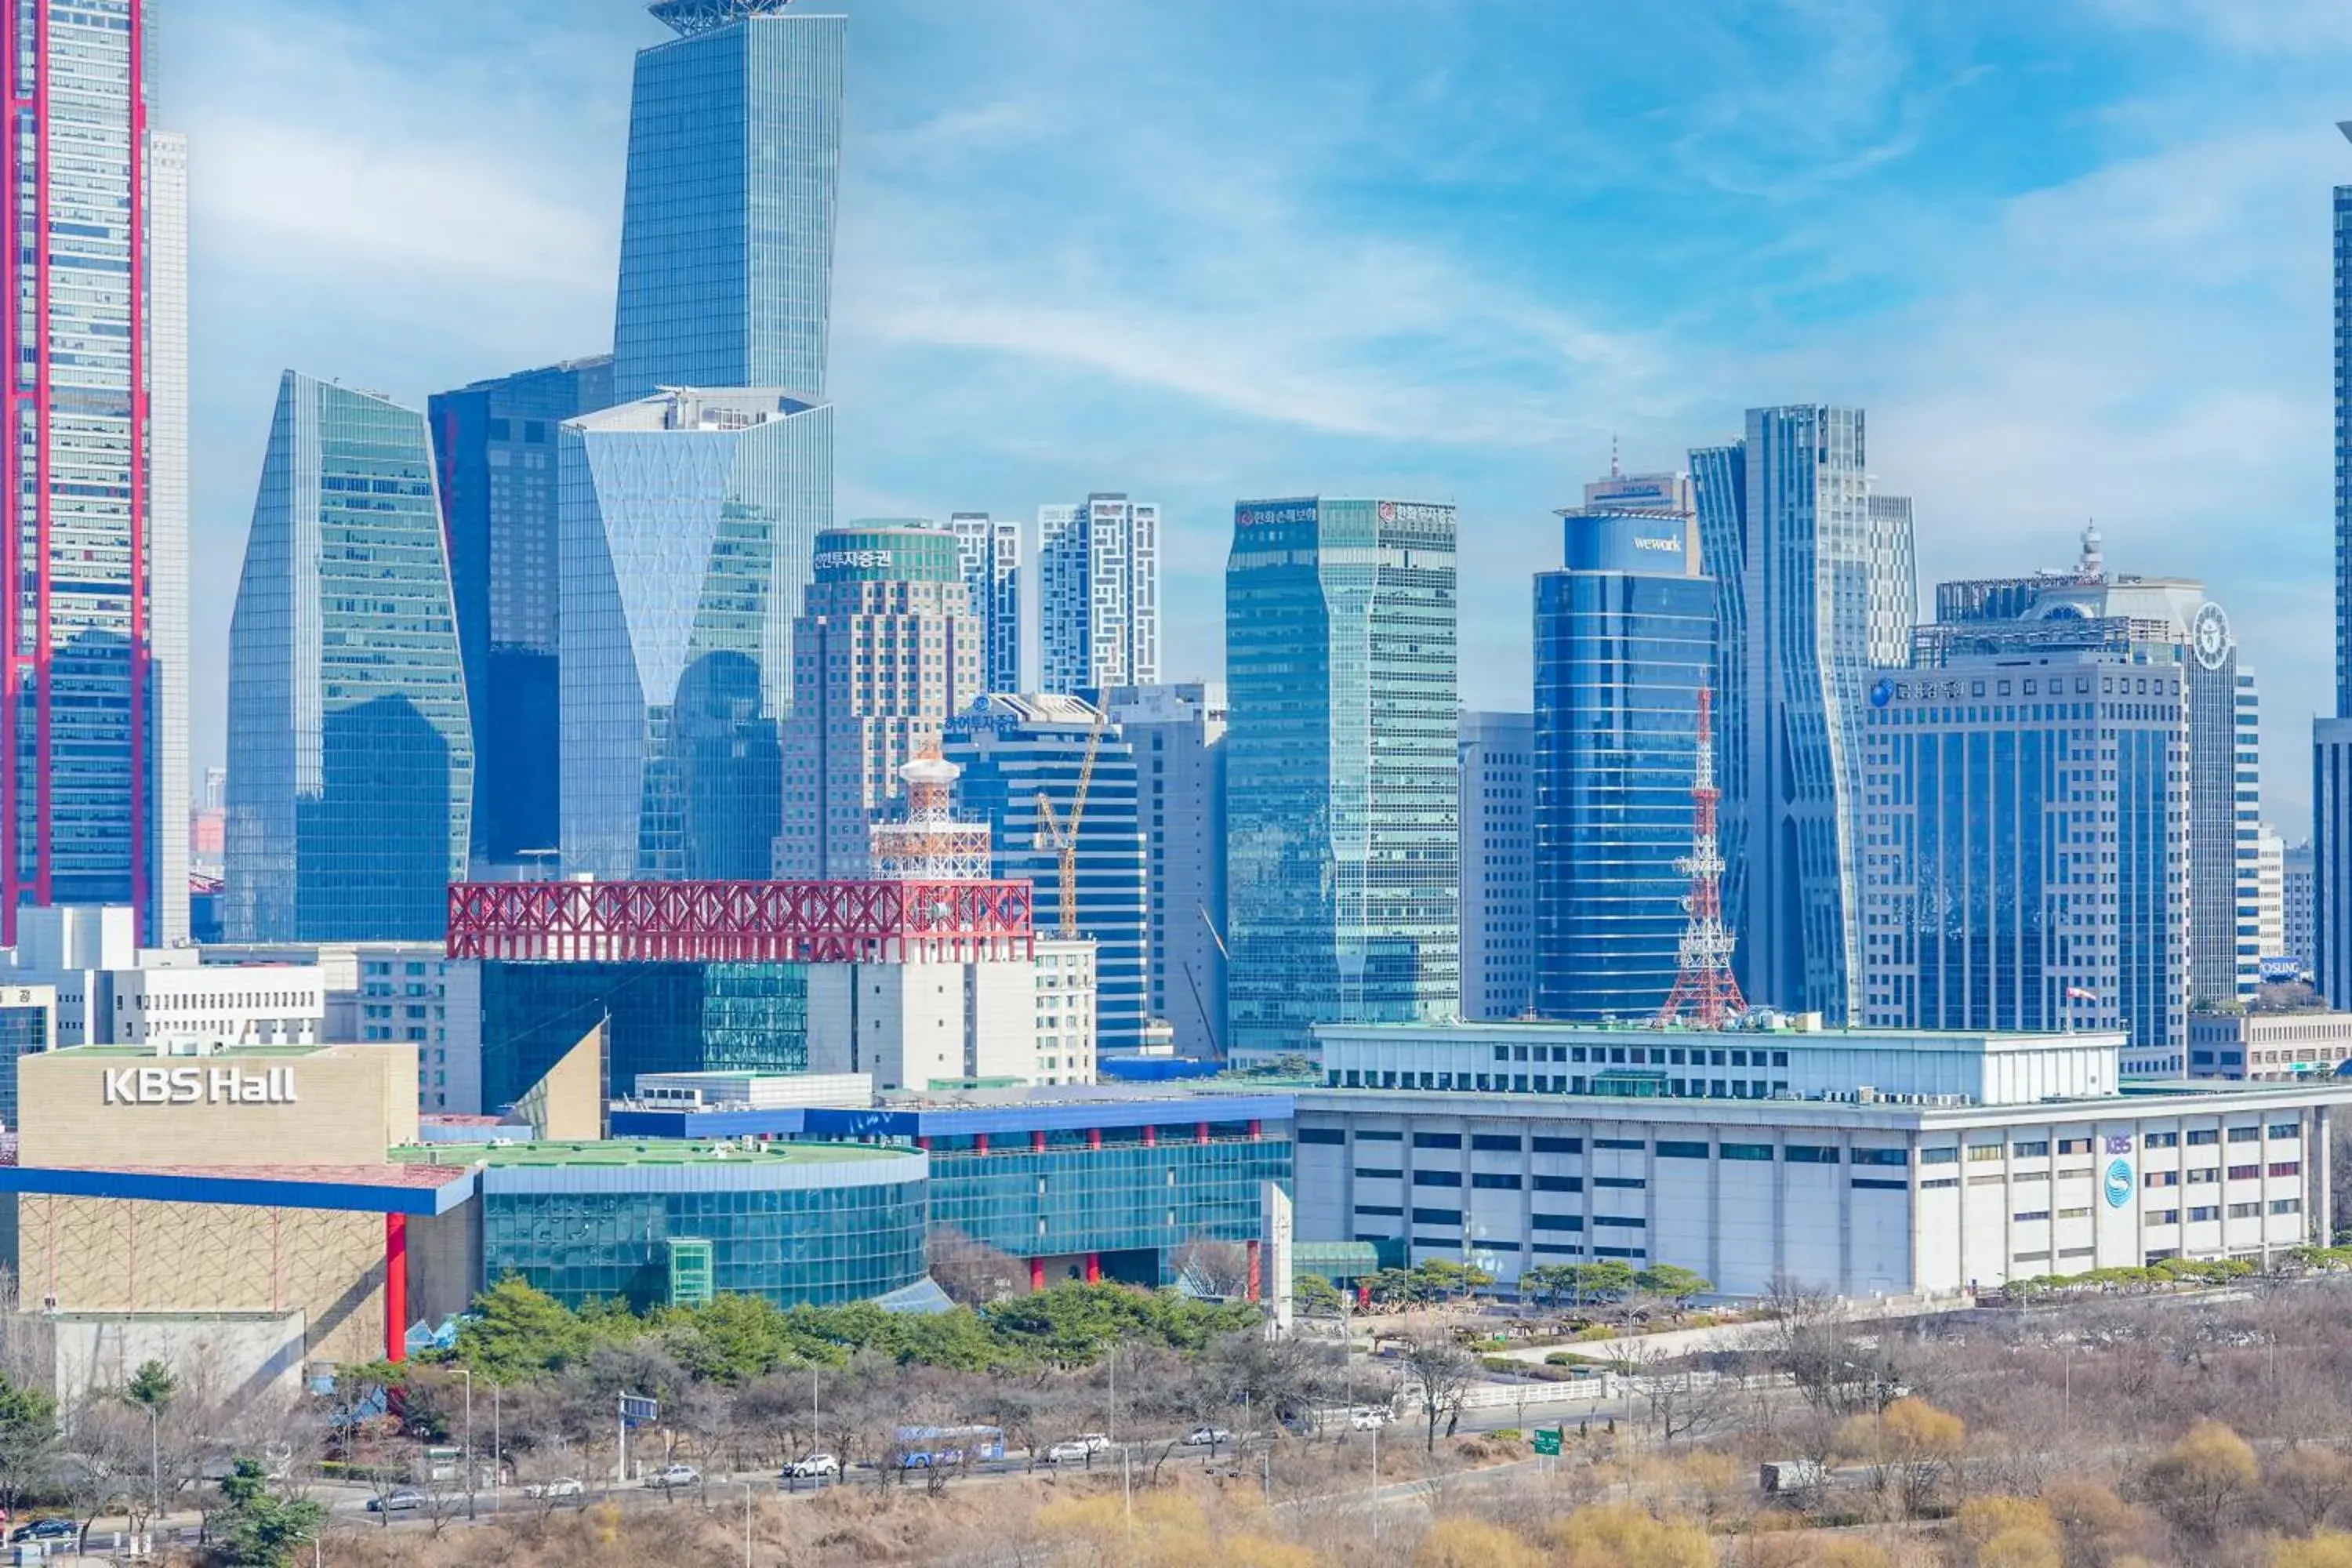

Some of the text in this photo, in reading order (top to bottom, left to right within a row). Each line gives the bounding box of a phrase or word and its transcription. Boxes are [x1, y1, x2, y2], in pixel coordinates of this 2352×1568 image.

[1632, 534, 1682, 551] wework
[104, 1066, 298, 1104] KBS Hall
[2106, 1136, 2132, 1155] KBS
